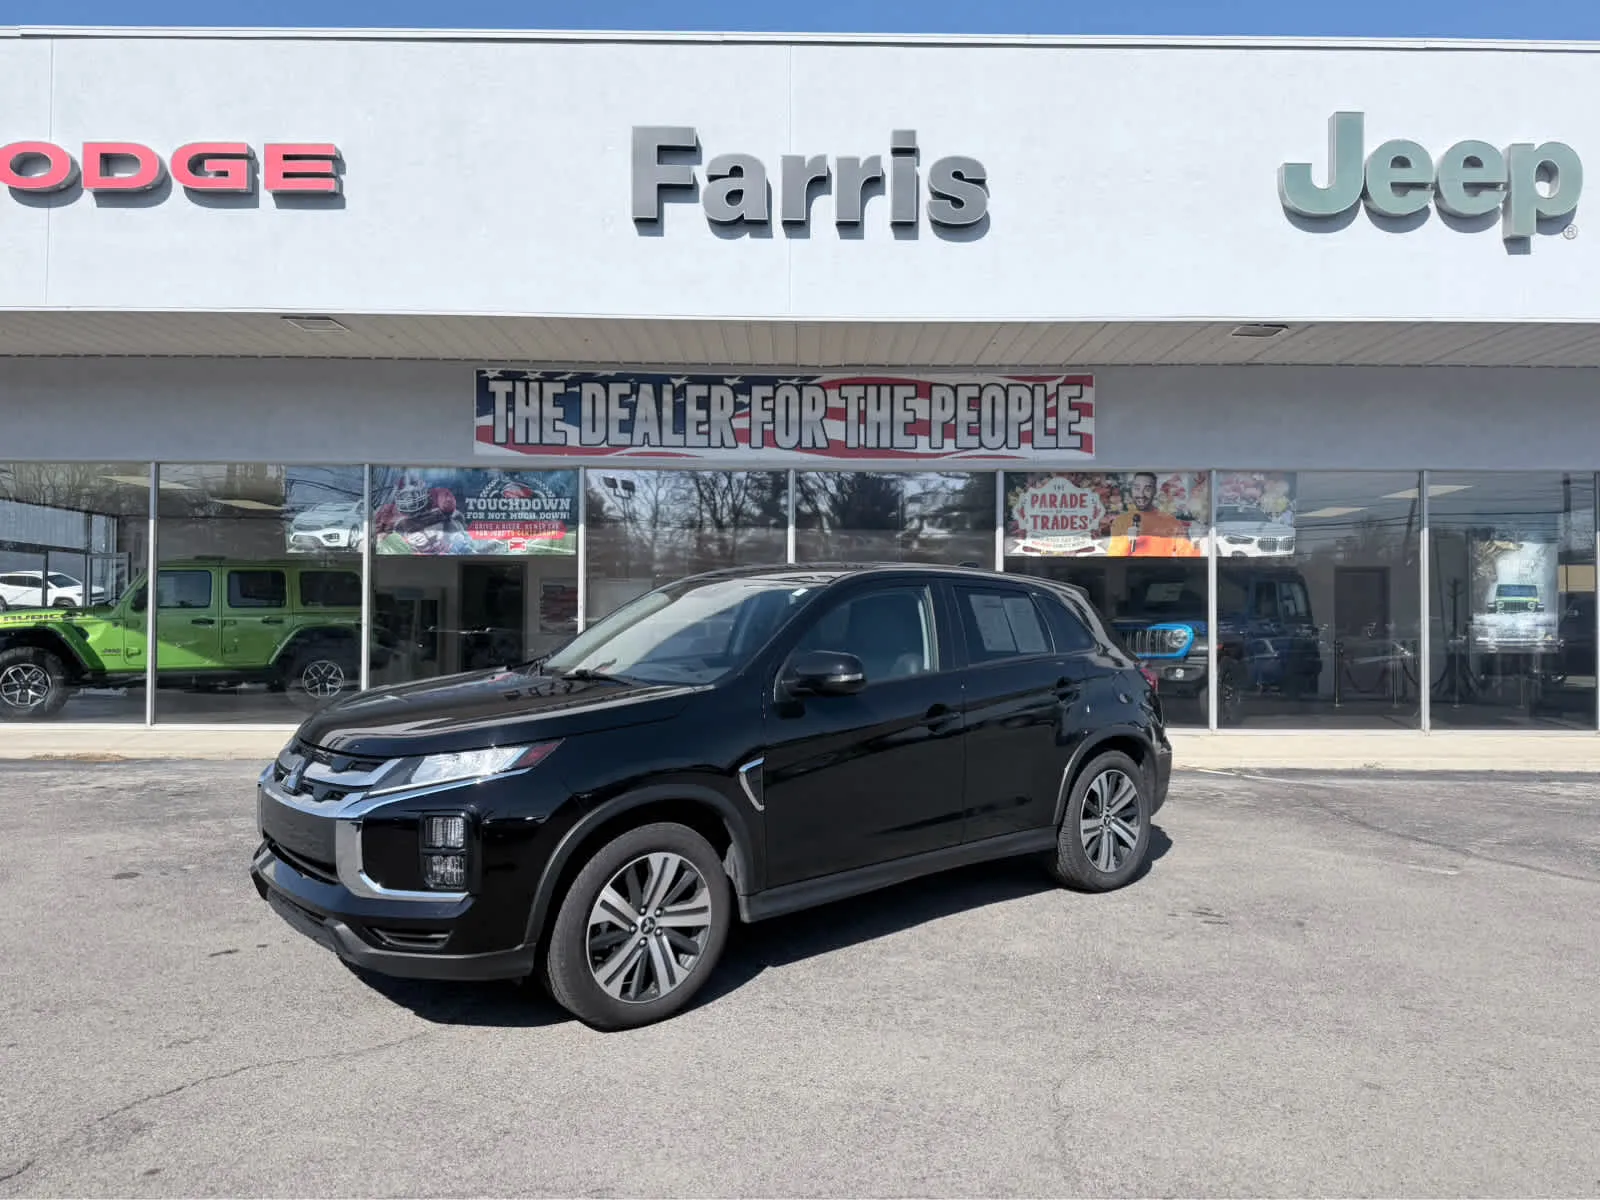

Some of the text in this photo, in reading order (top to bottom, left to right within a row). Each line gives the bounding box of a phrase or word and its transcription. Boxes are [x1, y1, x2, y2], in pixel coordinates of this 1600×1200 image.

[631, 125, 989, 228] Farris
[1277, 111, 1584, 240] Jeep
[487, 379, 1083, 450] THE DEALER FOR THE PEOPLE
[465, 498, 572, 511] TOUCHDOWN
[1031, 494, 1088, 508] PARADE
[466, 511, 570, 520] FOR NOT MUCH DOWN!
[1030, 515, 1089, 530] TRADES
